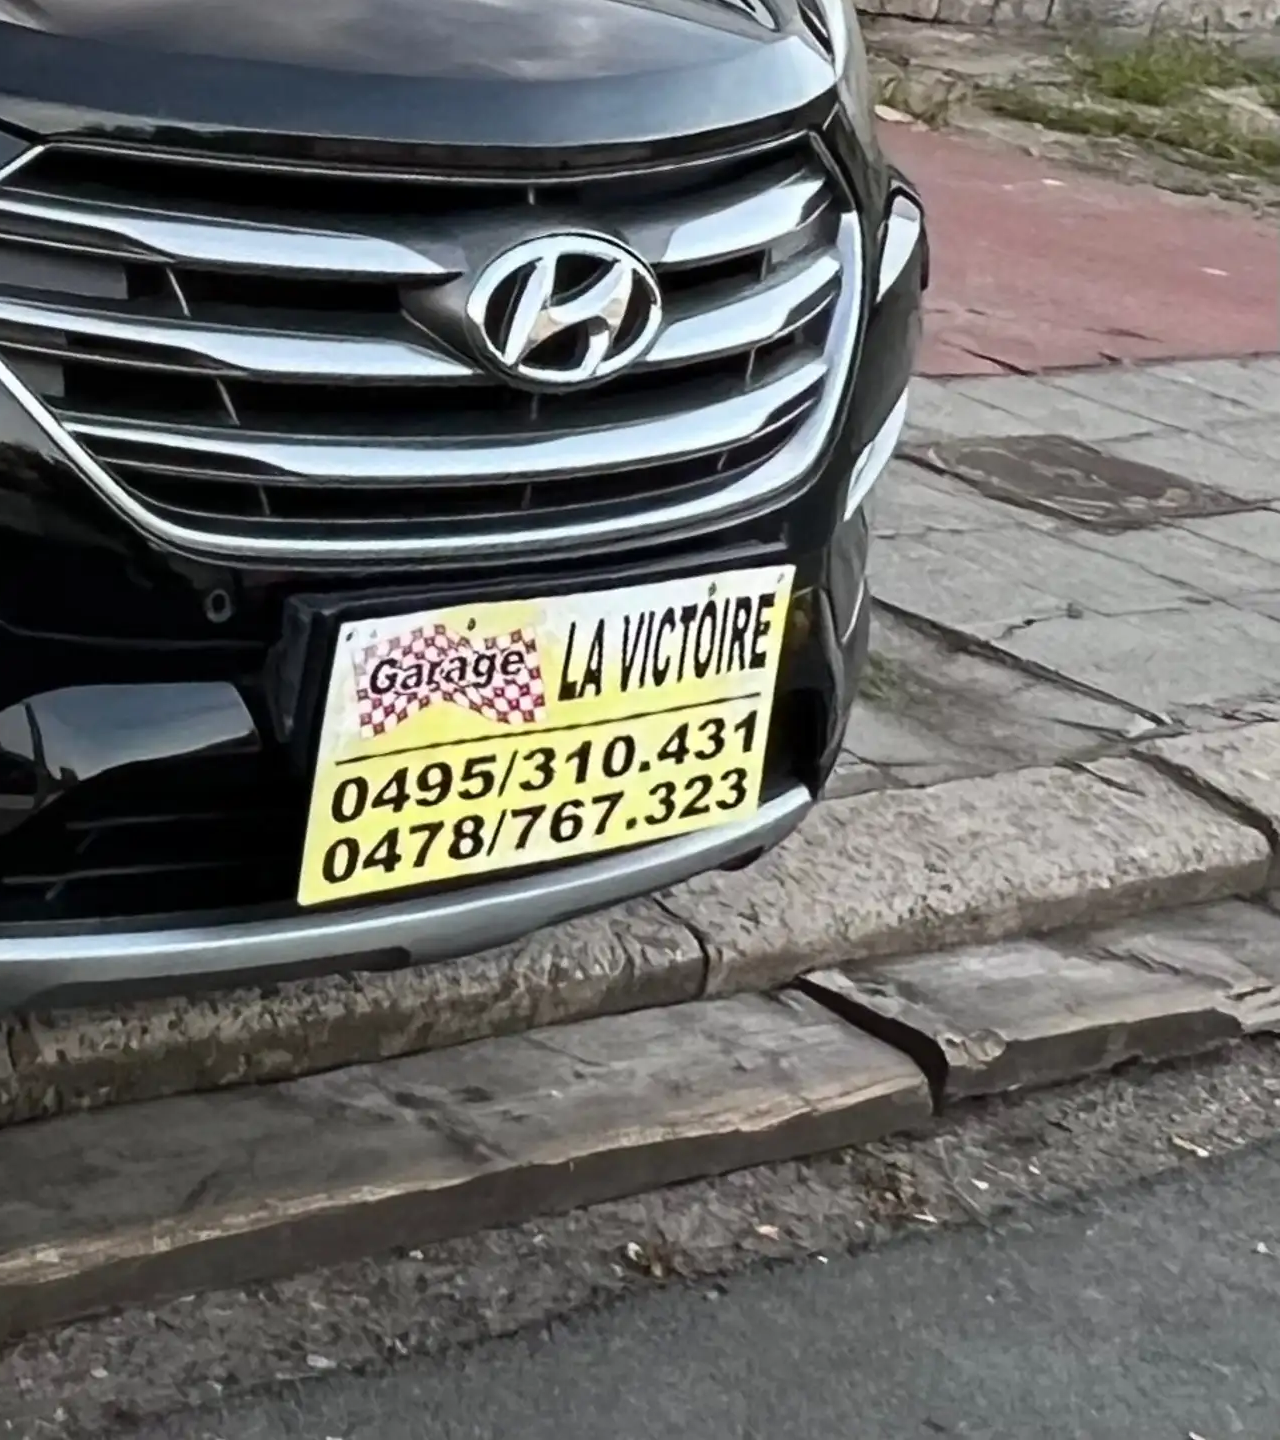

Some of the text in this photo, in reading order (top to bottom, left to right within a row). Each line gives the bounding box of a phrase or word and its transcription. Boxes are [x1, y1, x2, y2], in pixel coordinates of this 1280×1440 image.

[369, 593, 776, 701] Garage LA VICTOIRE
[331, 710, 757, 823] 0495/310.431
[322, 767, 747, 884] 0478/767.323
